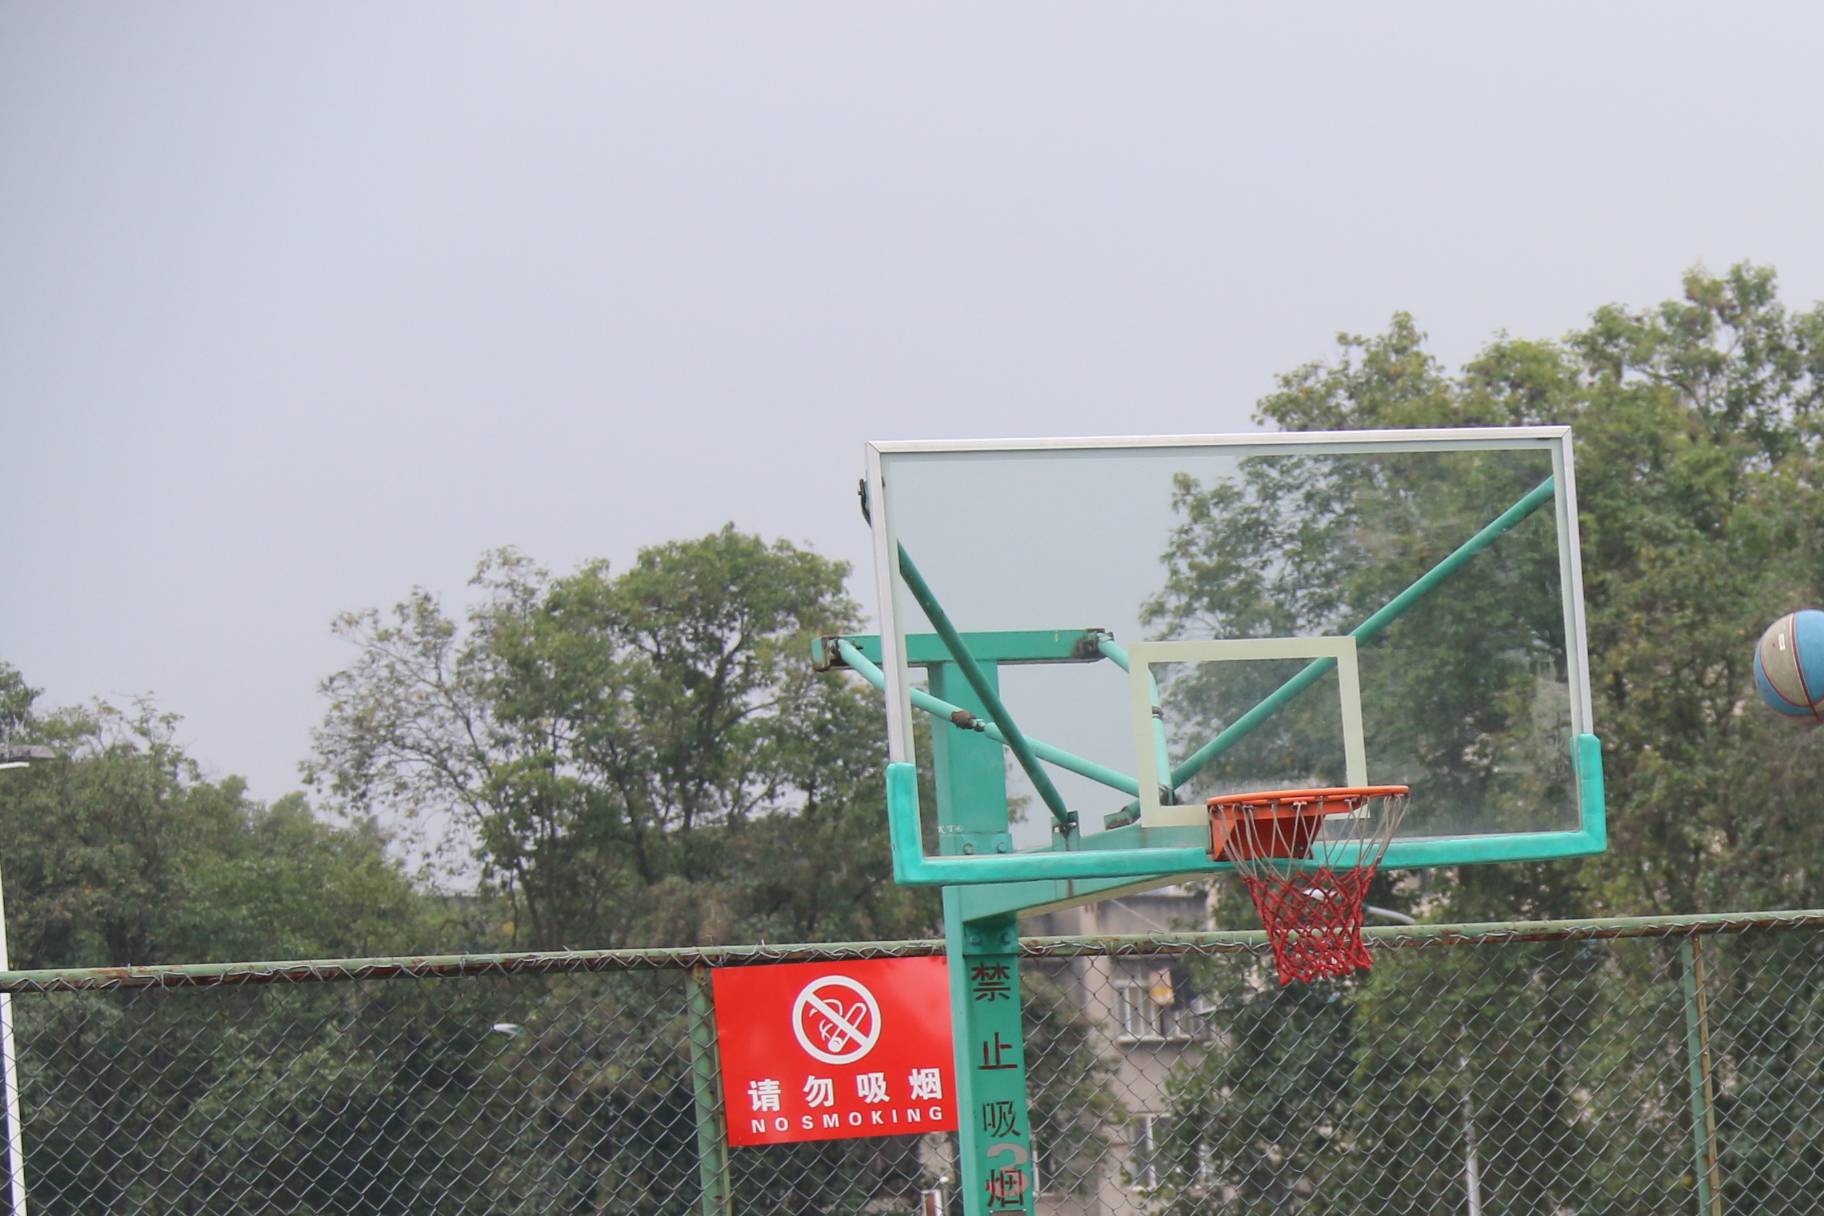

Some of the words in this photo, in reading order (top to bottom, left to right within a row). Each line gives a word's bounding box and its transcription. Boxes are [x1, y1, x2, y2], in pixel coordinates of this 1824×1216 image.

[748, 1067, 943, 1112] 请勿吸烟
[971, 963, 1025, 1207] 禁止吸烟
